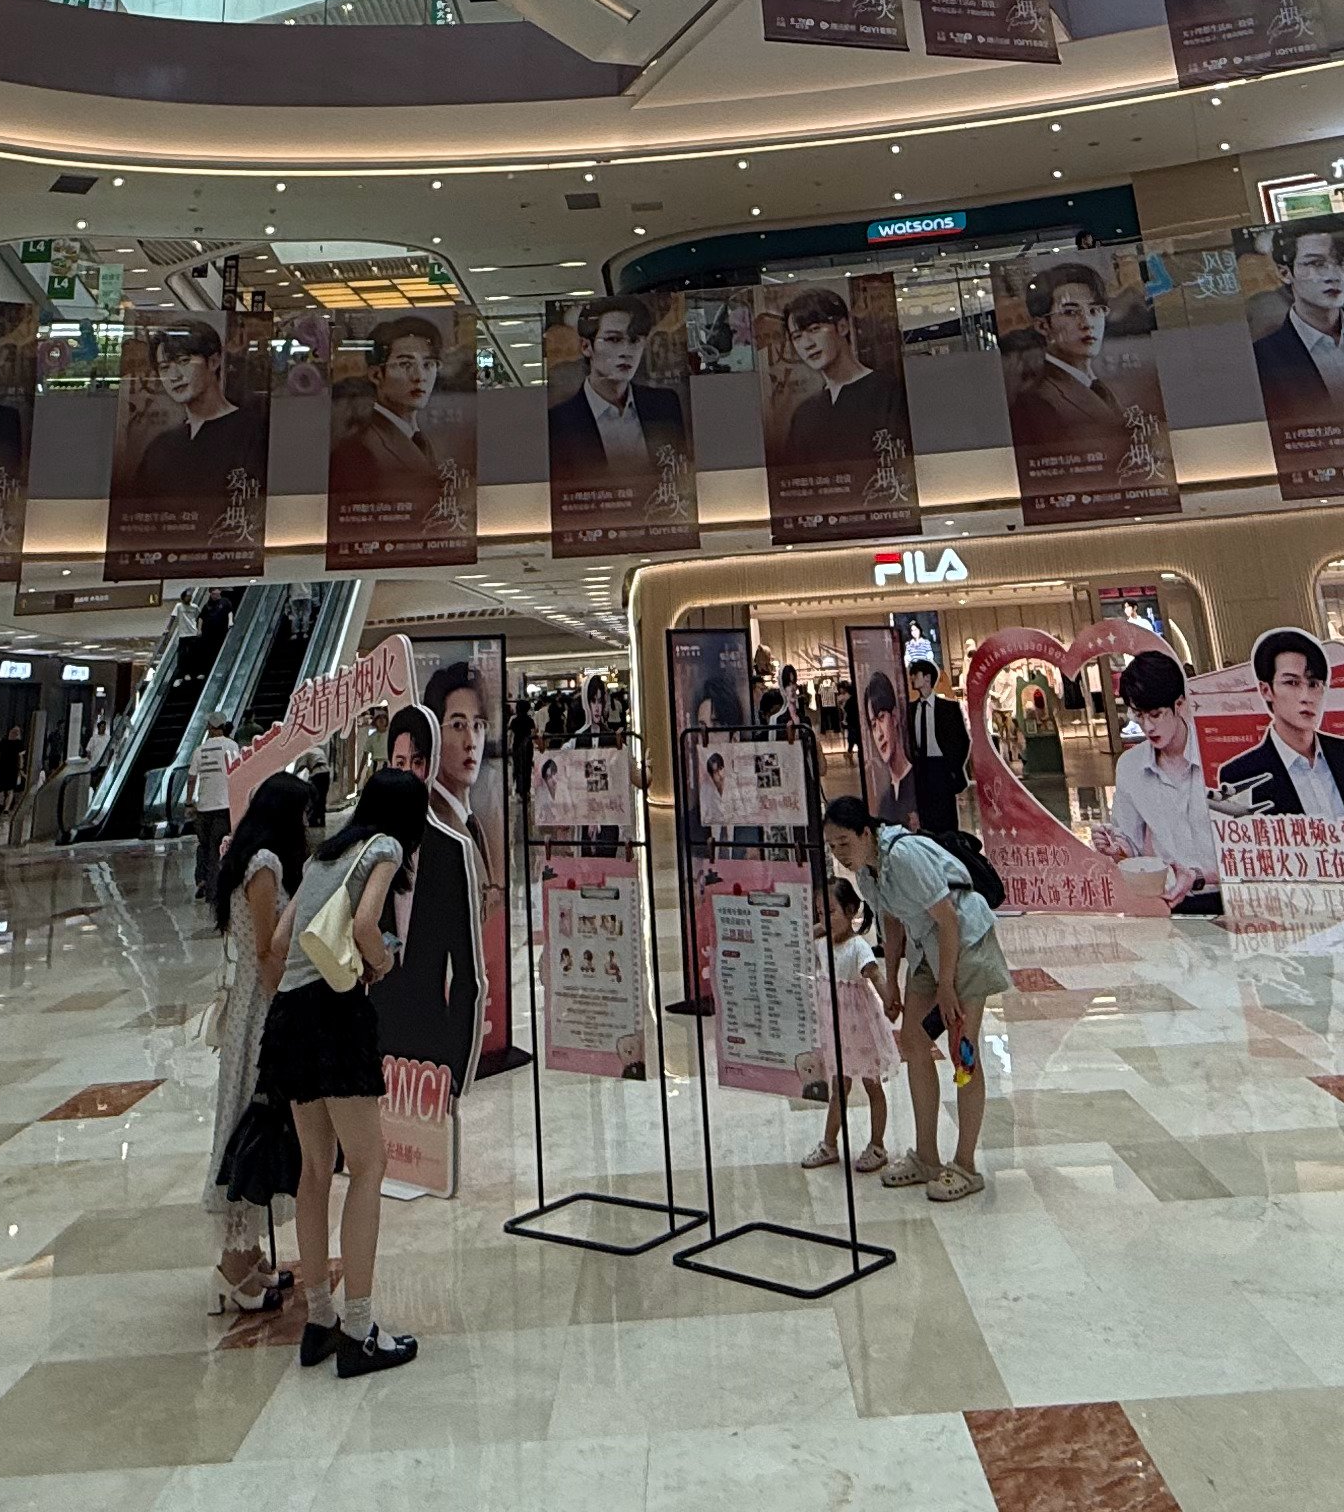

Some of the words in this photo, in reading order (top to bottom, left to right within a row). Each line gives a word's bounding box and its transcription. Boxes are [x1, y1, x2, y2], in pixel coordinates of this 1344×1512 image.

[877, 216, 955, 237] watsons
[29, 240, 46, 253] L4
[53, 277, 69, 289] L4
[874, 548, 968, 587] FILA
[281, 647, 406, 748] 爱情有烟火
